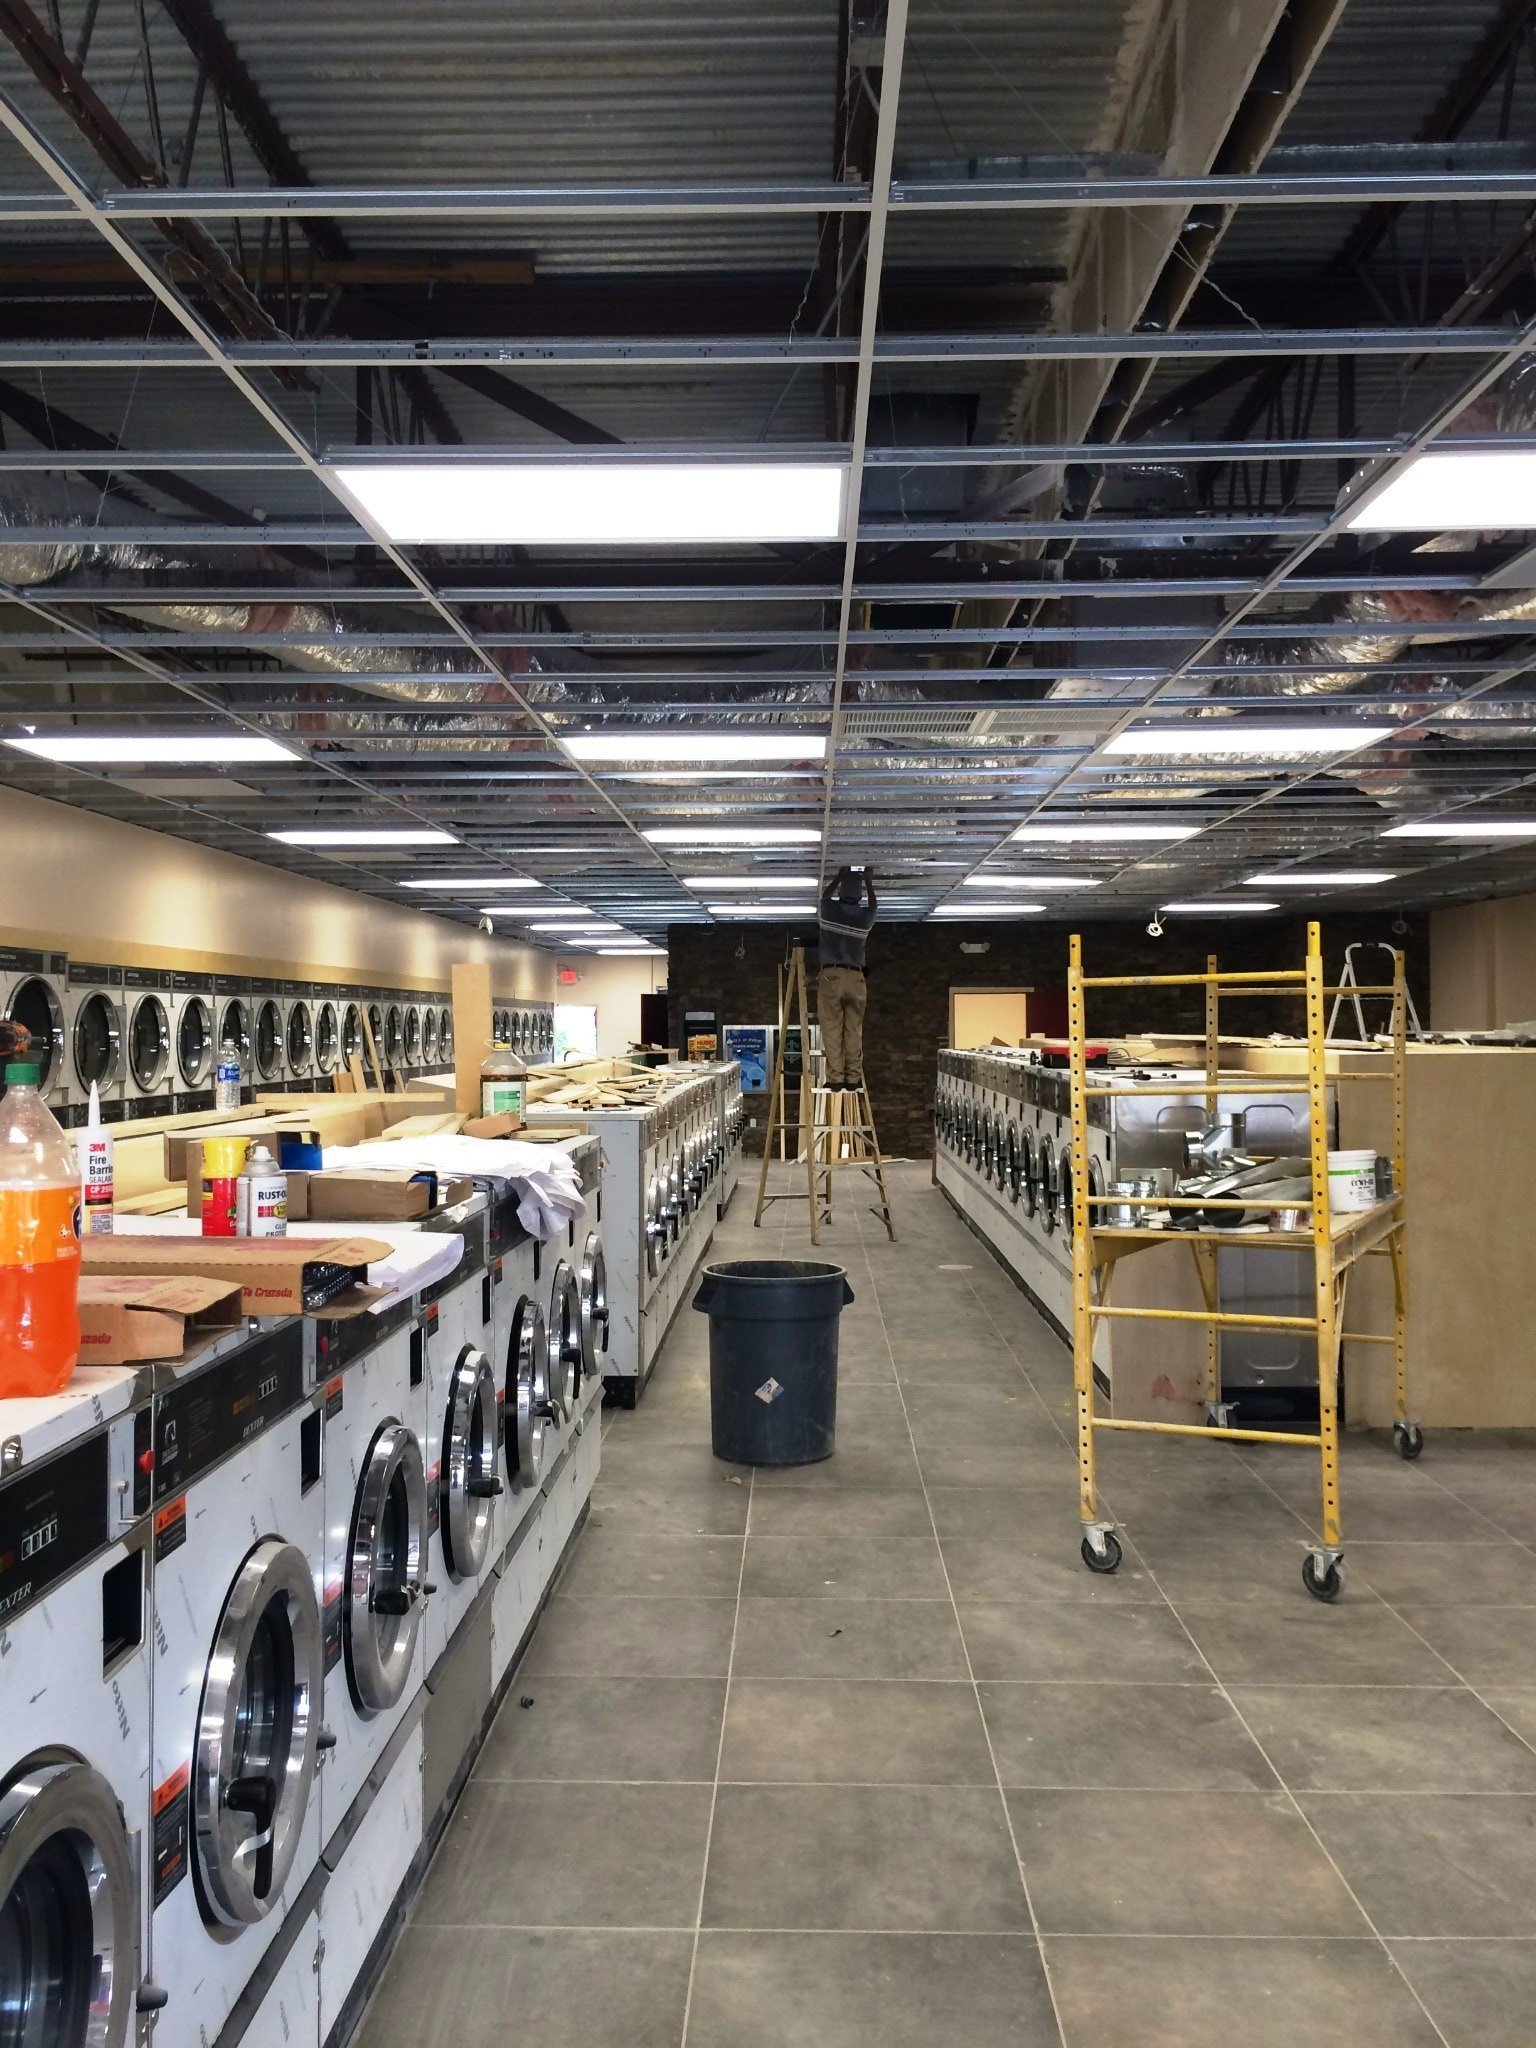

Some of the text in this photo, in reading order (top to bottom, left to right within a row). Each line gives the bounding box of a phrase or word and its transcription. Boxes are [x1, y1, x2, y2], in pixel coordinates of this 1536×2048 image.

[89, 1143, 106, 1152] 3M
[89, 1156, 107, 1165] Fire
[255, 1288, 292, 1298] Cruzada
[112, 1680, 130, 1740] Nitto
